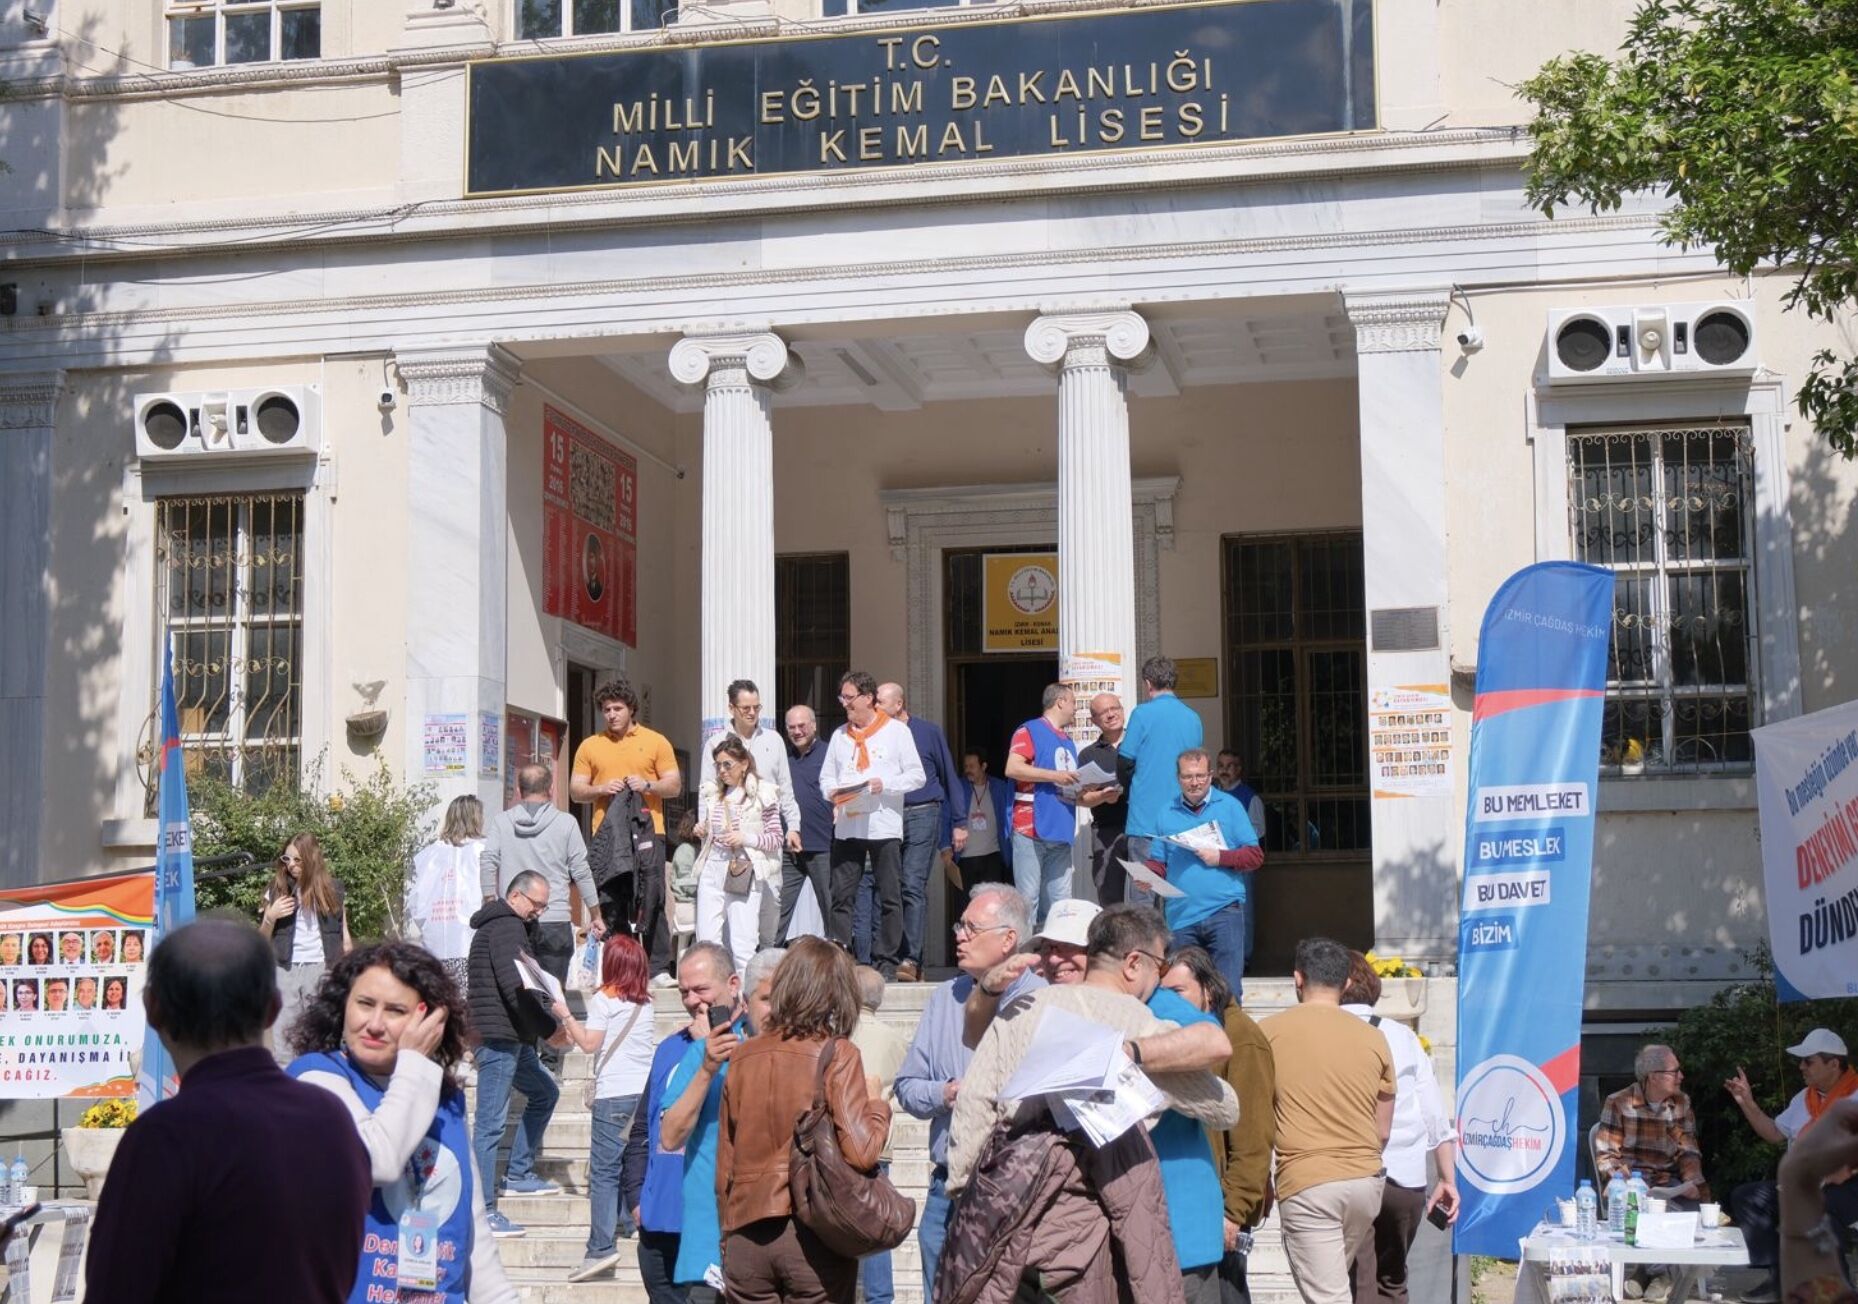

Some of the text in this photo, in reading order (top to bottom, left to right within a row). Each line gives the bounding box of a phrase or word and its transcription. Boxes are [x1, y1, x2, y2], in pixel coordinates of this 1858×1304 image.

[877, 34, 951, 70] T.C.
[612, 49, 1213, 134] MİLLİ EĞİTİM BAKANLIĞI
[595, 93, 1229, 178] NAMIK KEMAL LİSESİ
[1484, 791, 1583, 814] BU MEMLEKET
[1477, 879, 1547, 902] BU DAVET
[1472, 921, 1513, 945] BİZİM
[19, 1050, 111, 1064] DAYANIŞMA
